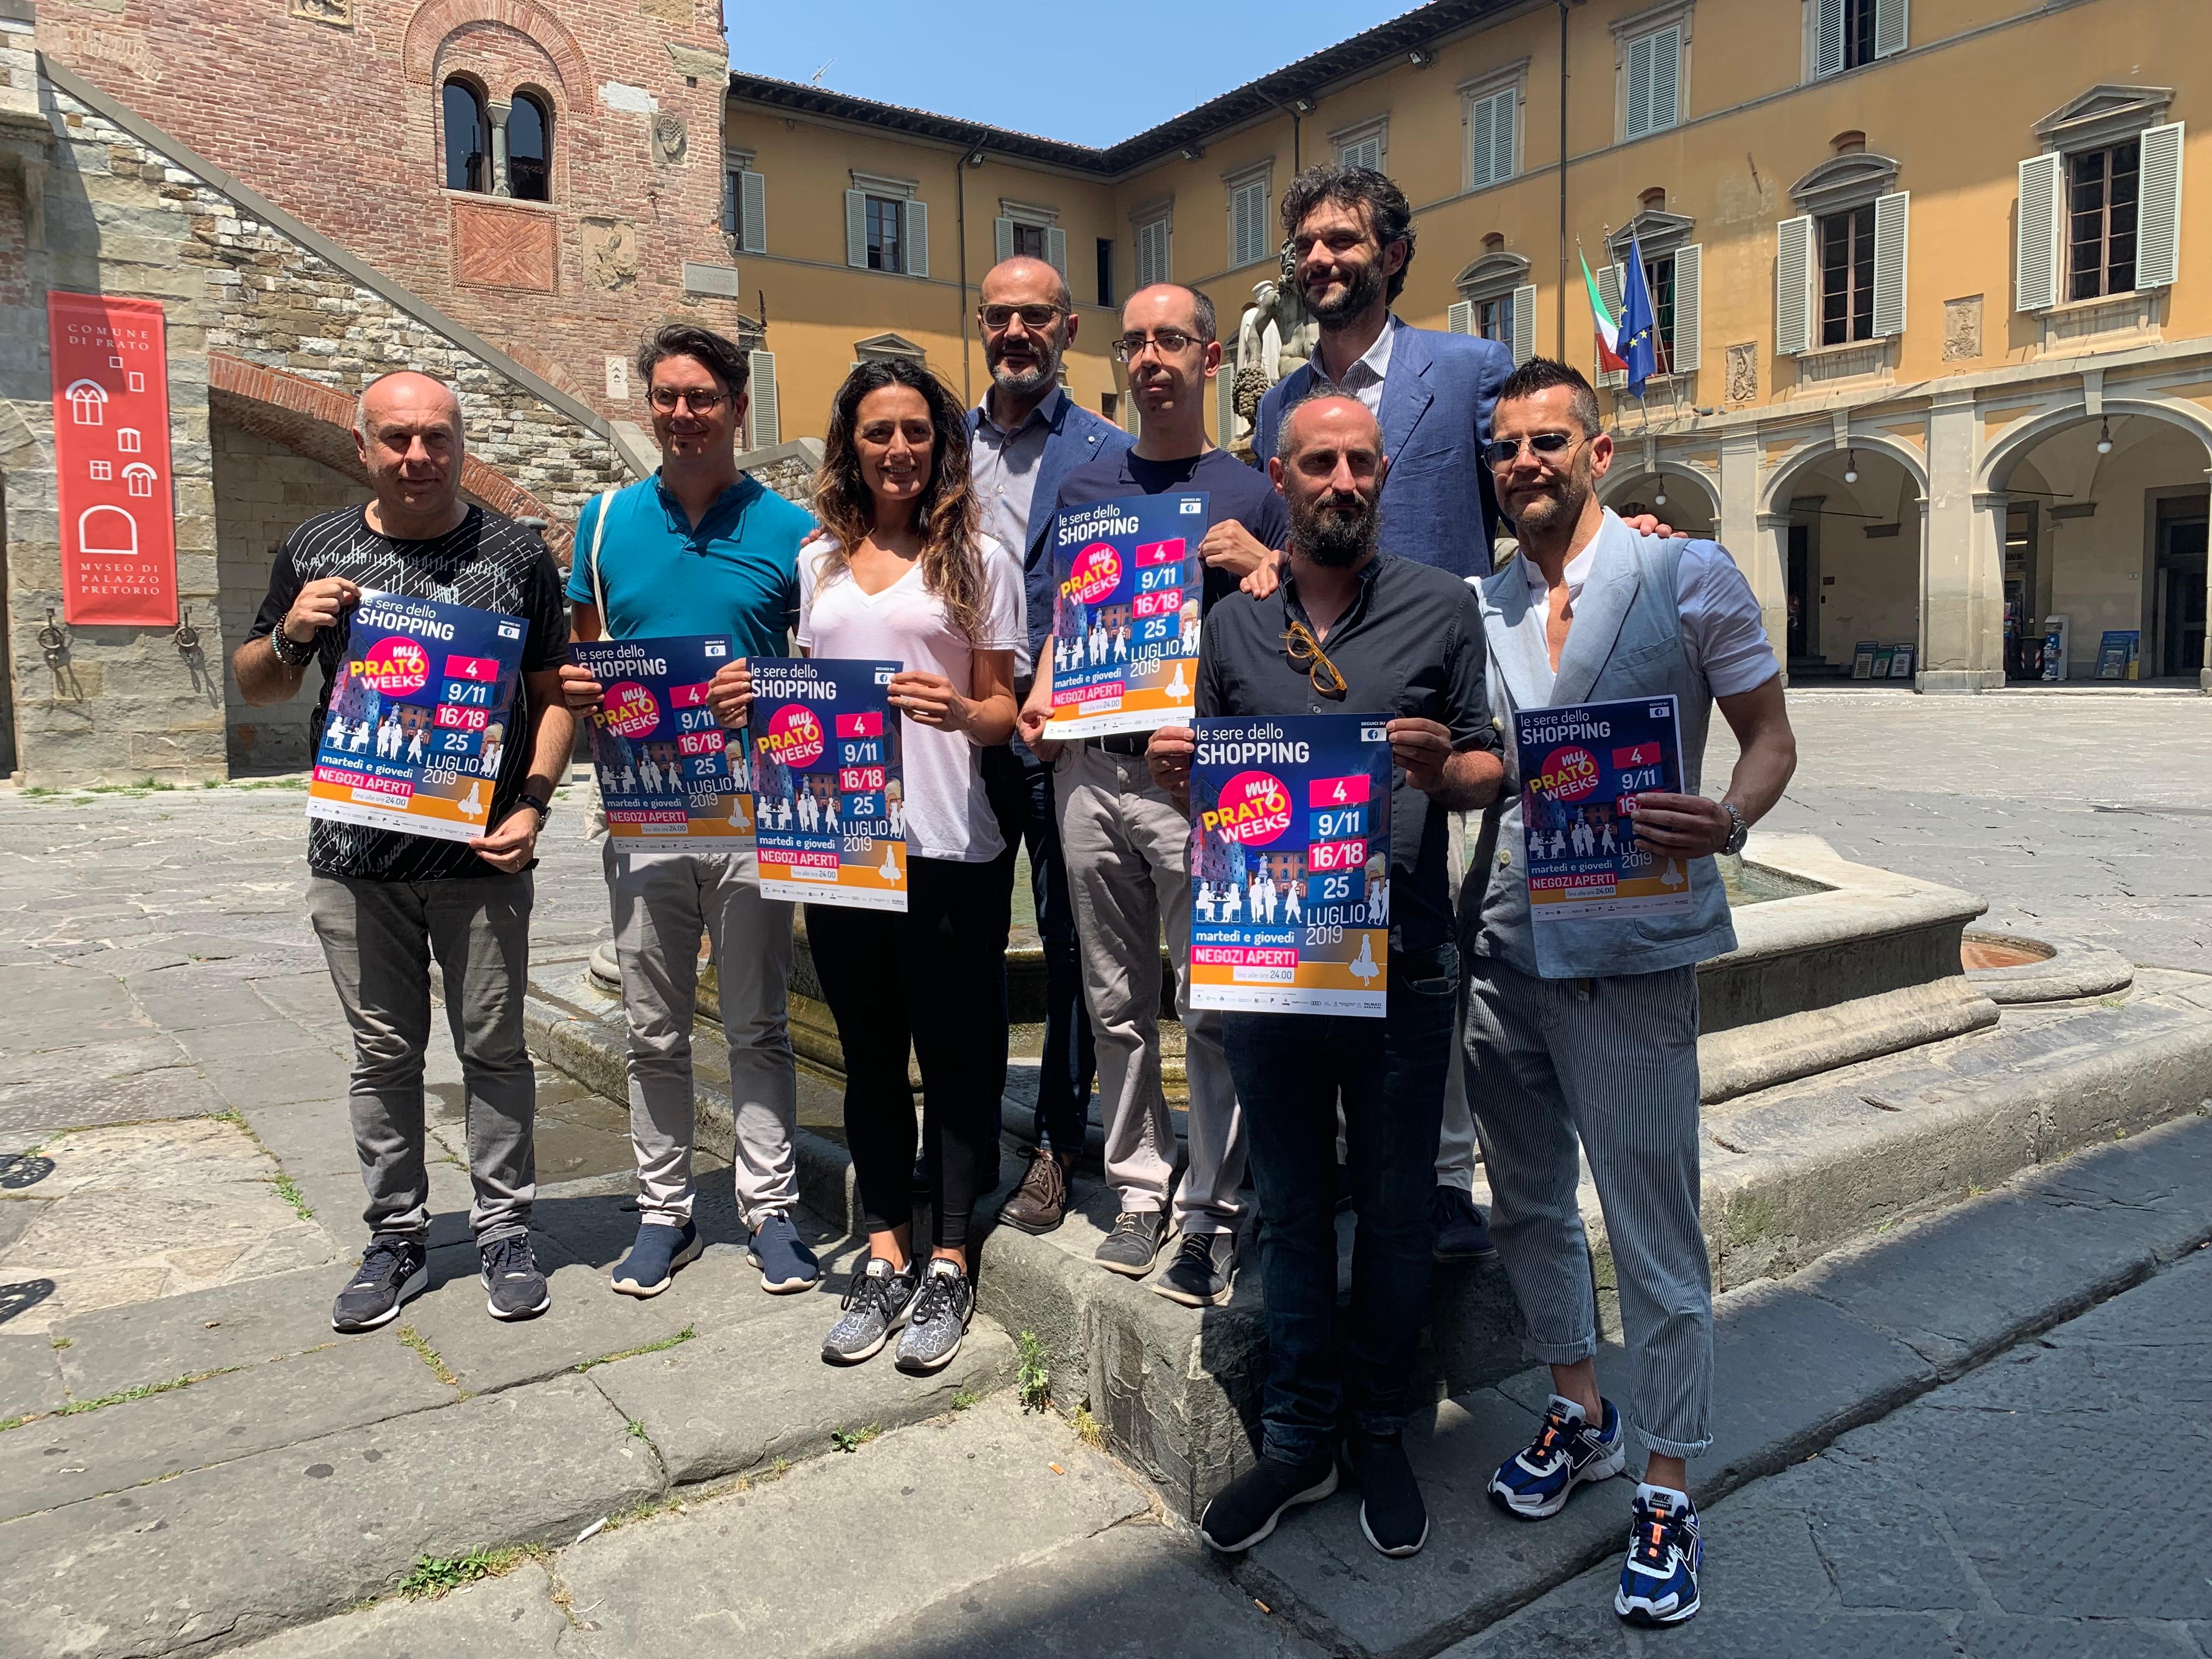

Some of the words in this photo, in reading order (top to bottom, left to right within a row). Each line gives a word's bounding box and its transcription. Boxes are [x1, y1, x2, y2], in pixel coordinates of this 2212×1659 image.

[67, 324, 149, 338] COMUNE
[69, 335, 87, 345] DI
[96, 338, 150, 351] PRATO
[1059, 514, 1069, 527] le
[1070, 510, 1091, 524] sere
[1093, 504, 1120, 518] dello
[1058, 517, 1139, 546] SHOPPING
[1089, 548, 1112, 570] my
[1153, 545, 1165, 560] 4
[80, 562, 134, 572] MVSEO
[142, 564, 158, 573] DI
[81, 574, 160, 583] PALAZZO
[1060, 558, 1118, 599] PRATO
[1141, 568, 1176, 588] 9/11
[81, 585, 160, 595] PRETORIO
[1070, 574, 1120, 606] WEEKS
[376, 601, 403, 613] sere
[405, 603, 436, 619] dello
[1135, 592, 1178, 615] 16/18
[356, 608, 454, 640] SHOPPING
[1144, 619, 1167, 639] 25
[393, 644, 421, 665] my
[575, 647, 586, 660] le
[589, 648, 614, 659] sere
[617, 645, 645, 658] dello
[1131, 640, 1180, 662] LUGLIO
[349, 660, 425, 676] PRATO
[465, 661, 478, 676] 4
[751, 663, 761, 676] le
[763, 667, 788, 677] sere
[790, 664, 817, 678] dello
[1130, 659, 1160, 678] 2019
[362, 675, 426, 690] WEEKS
[1055, 672, 1084, 689] martedì
[1085, 675, 1091, 684] e
[1092, 668, 1122, 684] giovedì
[448, 684, 486, 704] 9/11
[622, 687, 646, 708] my
[689, 687, 699, 703] 4
[752, 679, 836, 700] SHOPPING
[1054, 690, 1085, 705] NEGOZI
[1087, 684, 1122, 699] APERTI
[592, 697, 654, 729] PRATO
[1103, 699, 1120, 708] 24.00
[439, 707, 486, 728] 16/18
[607, 712, 660, 737] WEEKS
[681, 710, 715, 730] 9/11
[788, 711, 813, 735] my
[854, 716, 865, 735] 4
[1521, 715, 1531, 727] le
[1534, 714, 1559, 726] sere
[1561, 709, 1589, 723] dello
[757, 725, 819, 754] PRATO
[1197, 724, 1208, 740] le
[1212, 728, 1244, 741] sere
[1247, 723, 1283, 740] dello
[1522, 721, 1611, 745] SHOPPING
[444, 734, 468, 751] 25
[681, 733, 722, 753] 16/18
[844, 742, 877, 762] 9/11
[770, 741, 823, 765] WEEKS
[1197, 742, 1310, 765] SHOPPING
[1561, 750, 1587, 771] my
[1631, 748, 1642, 763] 4
[321, 755, 363, 769] martedì
[375, 764, 413, 778] giovedì
[426, 754, 479, 772] LUGLIO
[696, 758, 716, 775] 25
[318, 770, 364, 787] NEGOZI
[365, 777, 411, 795] APERTI
[422, 770, 456, 785] 2019
[687, 777, 732, 795] LUGLIO
[842, 769, 883, 788] 16/18
[1529, 761, 1594, 794] PRATO
[1621, 770, 1656, 789] 9/11
[1245, 777, 1278, 805] my
[1333, 783, 1347, 802] 4
[1542, 775, 1599, 802] WEEKS
[385, 796, 406, 806] 24.00
[607, 799, 641, 808] martedì
[651, 798, 681, 809] giovedì
[689, 793, 719, 808] 2019
[854, 796, 874, 815] 25
[610, 811, 647, 822] NEGOZI
[649, 811, 685, 821] APERTI
[1202, 794, 1286, 832] PRATO
[843, 820, 888, 836] LUGLIO
[1218, 812, 1290, 844] WEEKS
[1318, 811, 1359, 836] 9/11
[760, 836, 793, 847] martedì
[804, 838, 835, 850] giovedì
[843, 836, 872, 852] 2019
[760, 849, 798, 863] NEGOZI
[800, 853, 837, 866] APERTI
[1312, 843, 1363, 867] 16/18
[1621, 853, 1652, 868] 2019
[819, 870, 836, 878] 24.00
[1531, 862, 1568, 873] martedì
[1579, 860, 1612, 872] giovedì
[1323, 876, 1350, 899] 25
[1532, 877, 1572, 889] NEGOZI
[1575, 873, 1615, 886] APERTI
[1307, 904, 1365, 927] LUGLIO
[1196, 930, 1240, 943] martedì
[1254, 931, 1295, 945] giovedì
[1306, 925, 1342, 946] 2019
[1195, 950, 1244, 964] NEGOZI
[1246, 950, 1295, 965] APERTI
[1270, 970, 1292, 979] 24.00
[1553, 1401, 1567, 1411] NIKE
[1652, 1492, 1671, 1502] NIKE
